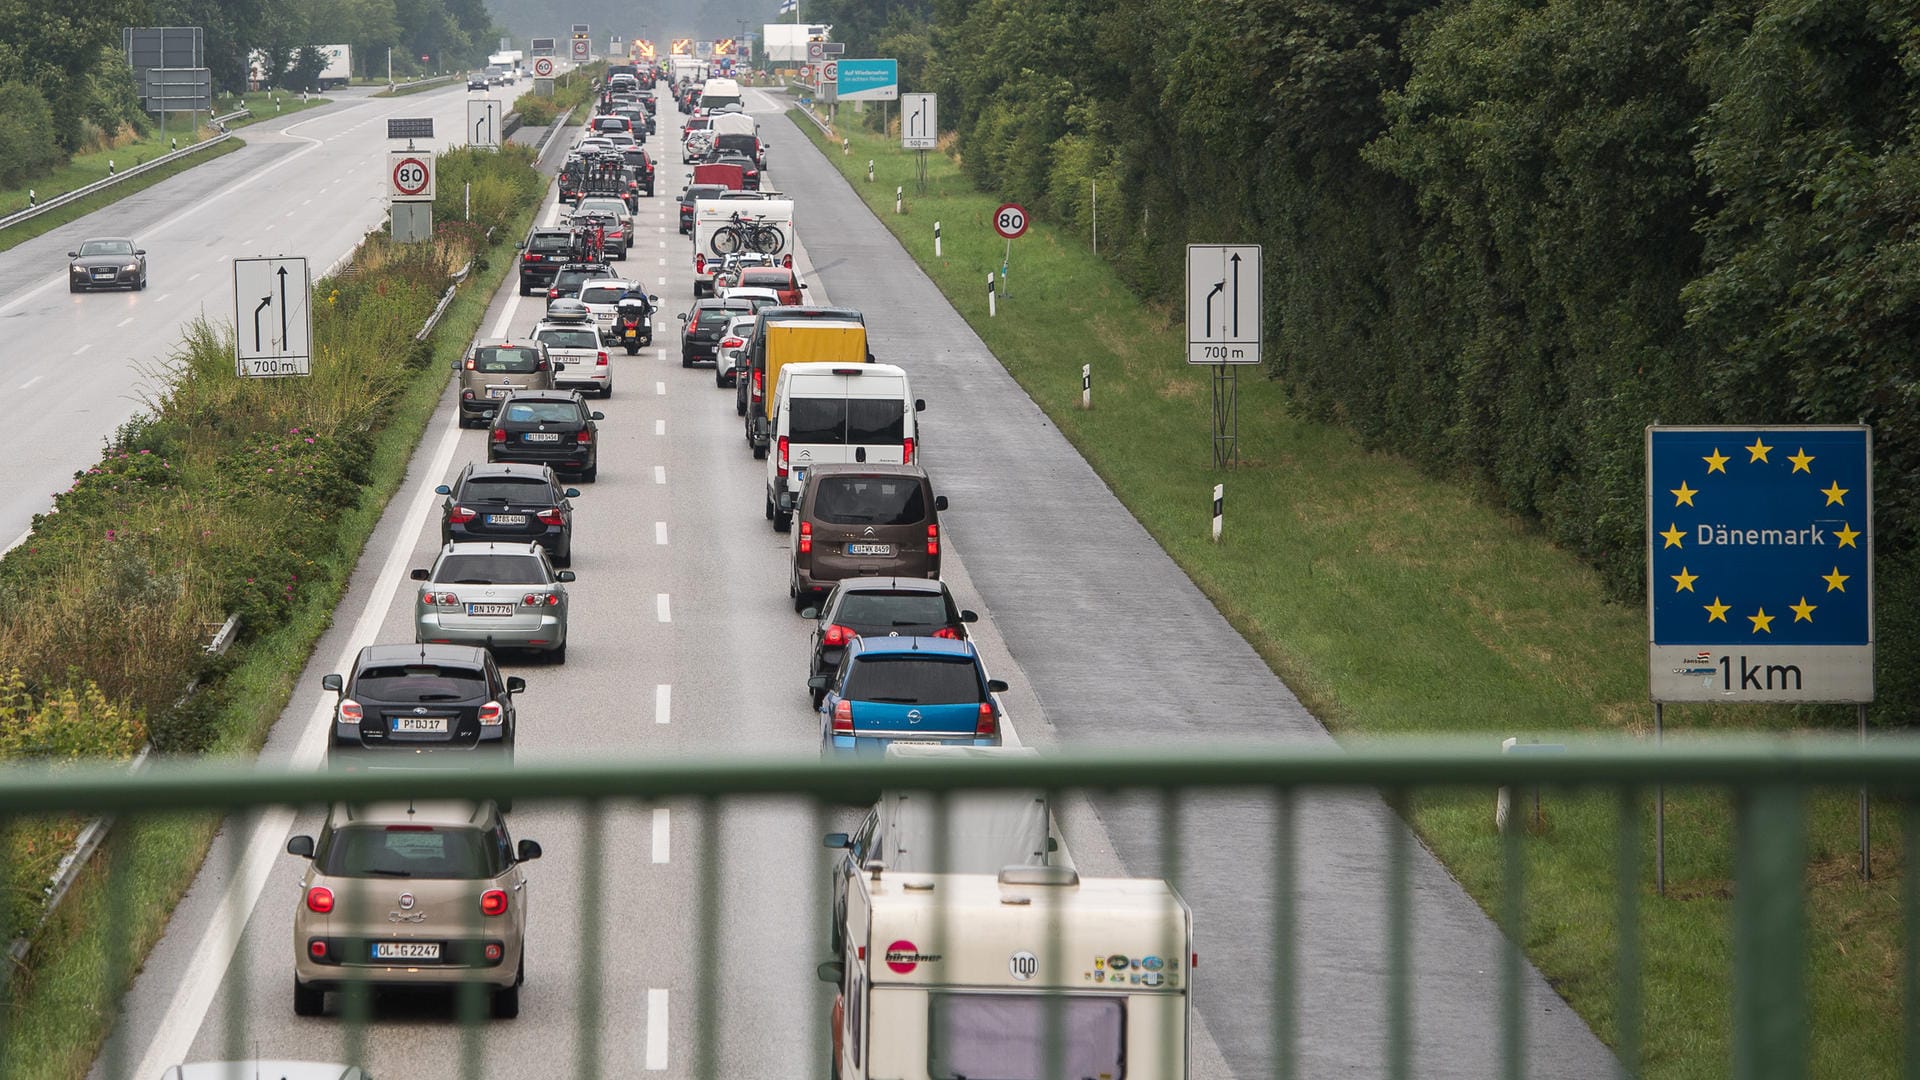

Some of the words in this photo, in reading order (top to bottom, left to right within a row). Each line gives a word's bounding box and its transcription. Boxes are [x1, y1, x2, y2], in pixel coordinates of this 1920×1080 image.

[400, 169, 422, 182] 80
[1000, 214, 1022, 229] 80
[1204, 346, 1227, 358] 700
[1232, 349, 1243, 358] m
[254, 361, 277, 373] 700
[282, 363, 293, 372] m
[1697, 523, 1825, 546] Dänemark
[404, 720, 410, 728] P
[415, 720, 428, 729] DJ
[429, 721, 440, 729] 17
[379, 944, 393, 956] OL
[400, 945, 408, 956] G
[410, 945, 437, 956] 2247
[1012, 957, 1035, 974] 100
